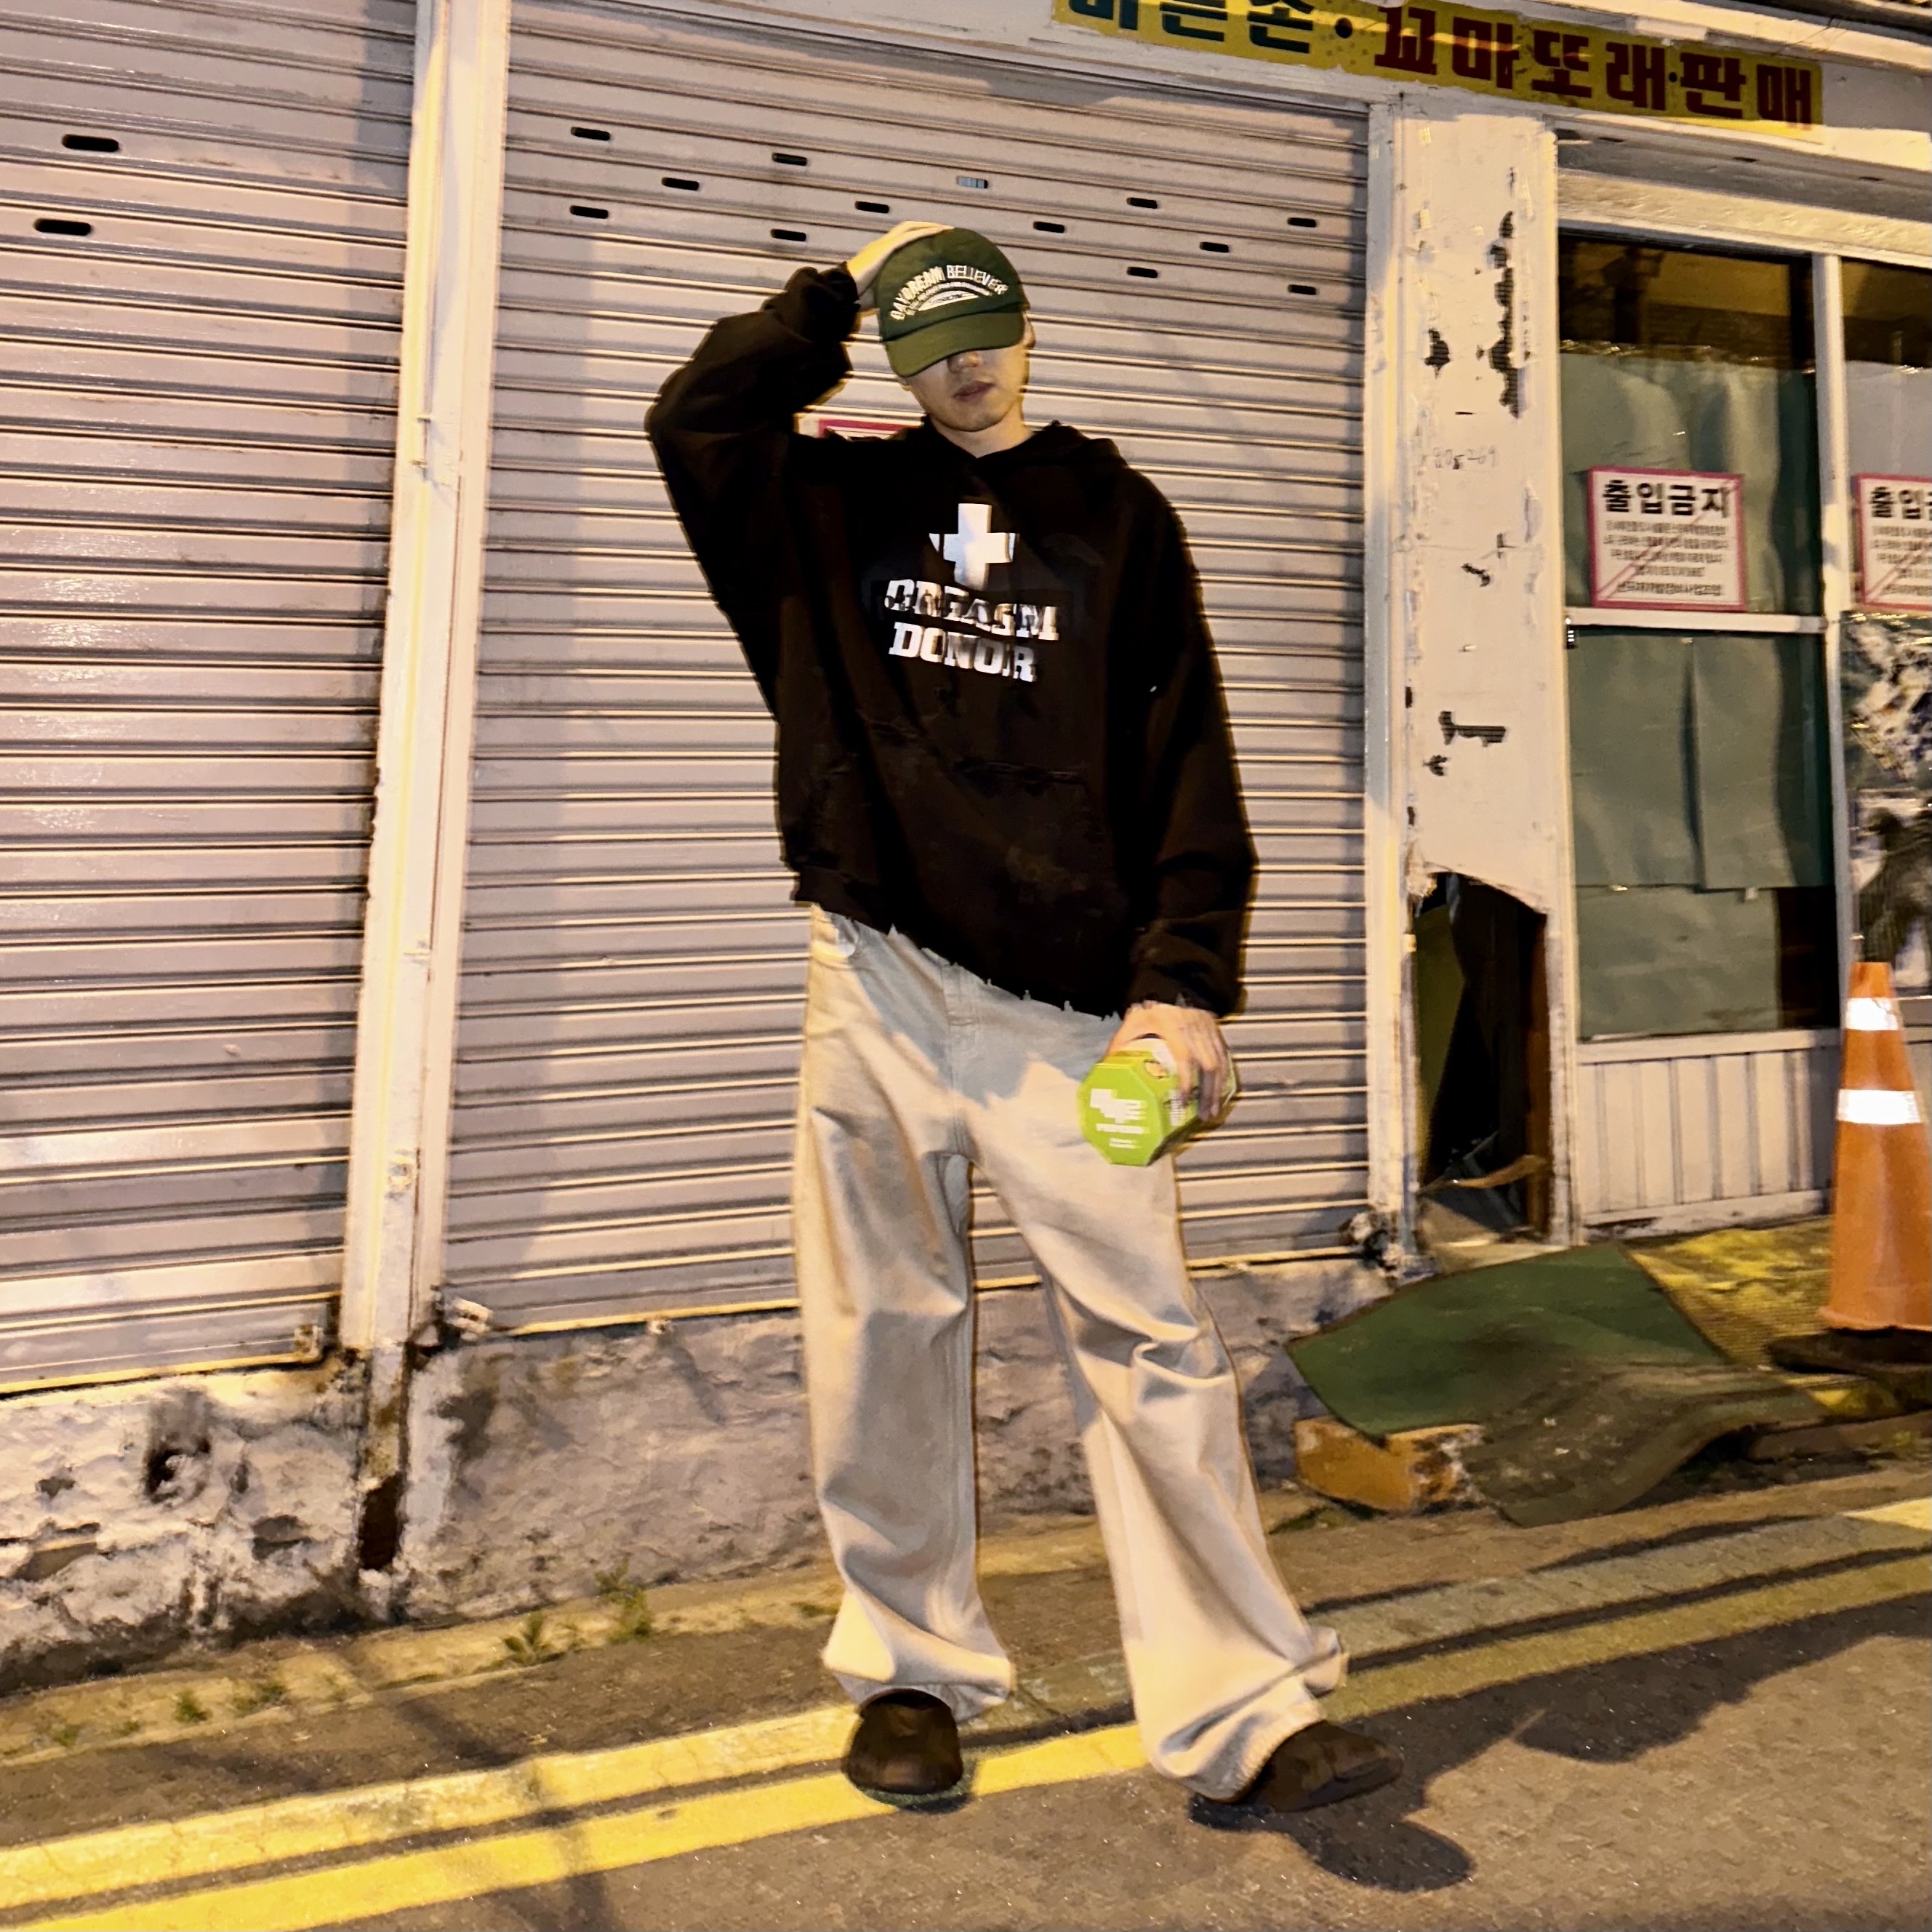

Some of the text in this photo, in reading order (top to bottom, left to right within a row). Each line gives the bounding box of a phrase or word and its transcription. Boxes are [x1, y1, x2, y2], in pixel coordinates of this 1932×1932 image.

[947, 265, 1009, 294] BELIEVER
[1603, 480, 1728, 518] 출입금지
[1869, 486, 1932, 521] 출입
[888, 622, 1038, 682] DONOR
